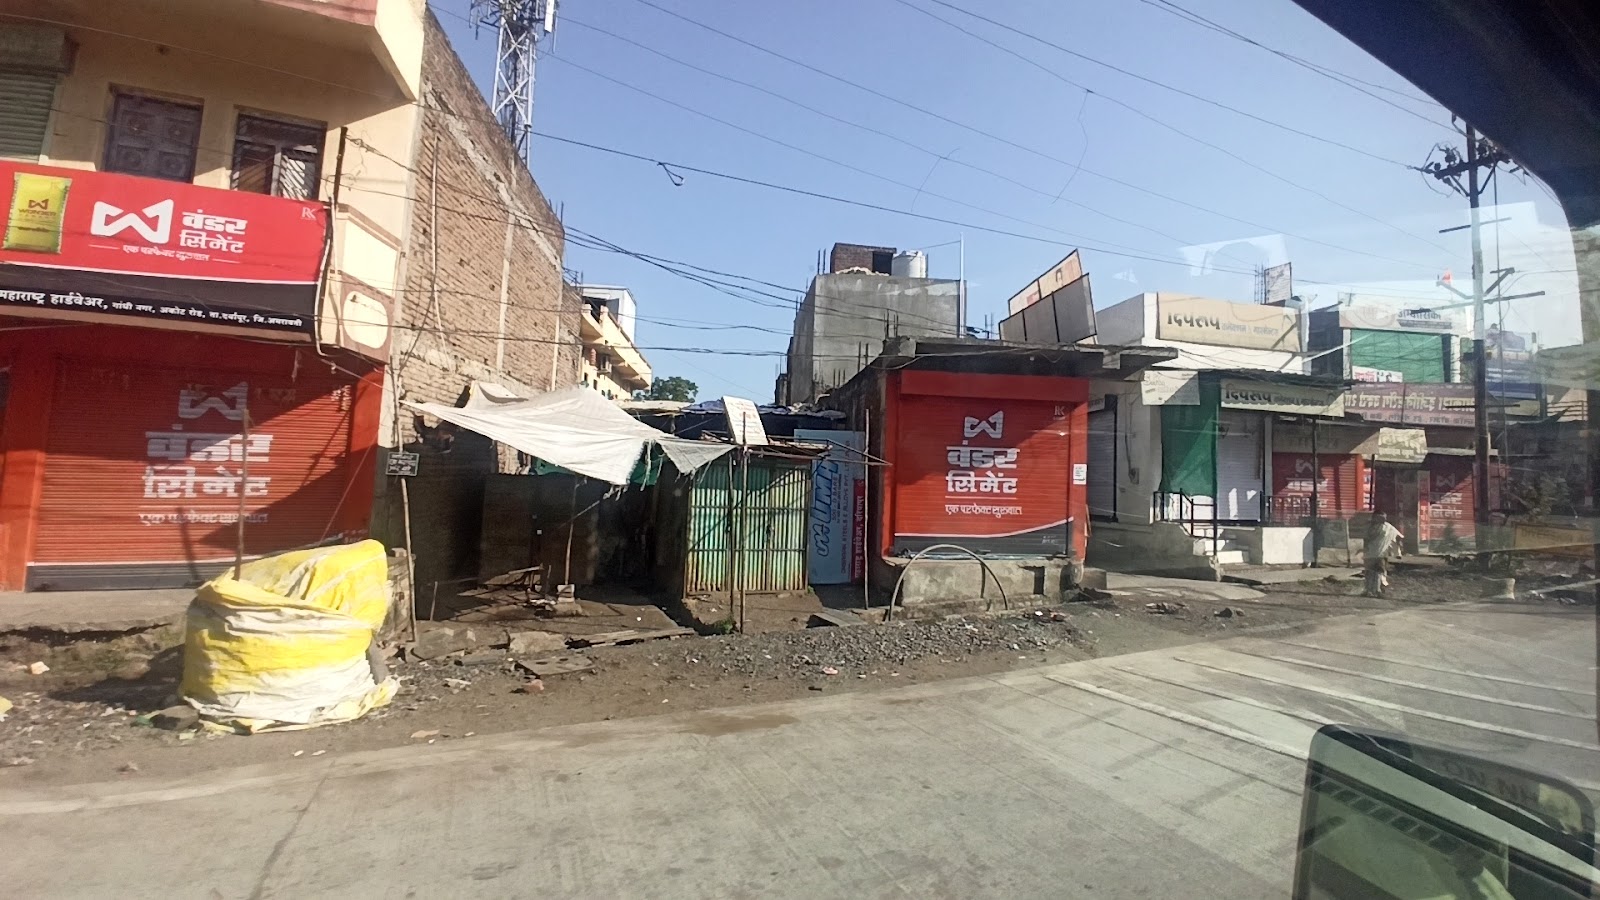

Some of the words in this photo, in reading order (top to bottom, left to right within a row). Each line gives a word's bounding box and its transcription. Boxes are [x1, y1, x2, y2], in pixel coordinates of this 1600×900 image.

[182, 208, 248, 234] वंडर
[122, 244, 139, 255] एक
[179, 231, 245, 254] सिमेंट
[0, 289, 46, 306] महाराष्ट्र
[50, 291, 109, 310] हार्डवेअर,
[145, 423, 274, 463] वंडर
[946, 439, 1021, 469] वंडर
[141, 464, 272, 500] सिमेंट
[945, 470, 1018, 495] सिमेंट
[944, 503, 960, 516] एक
[960, 502, 992, 515] परफेक्ट
